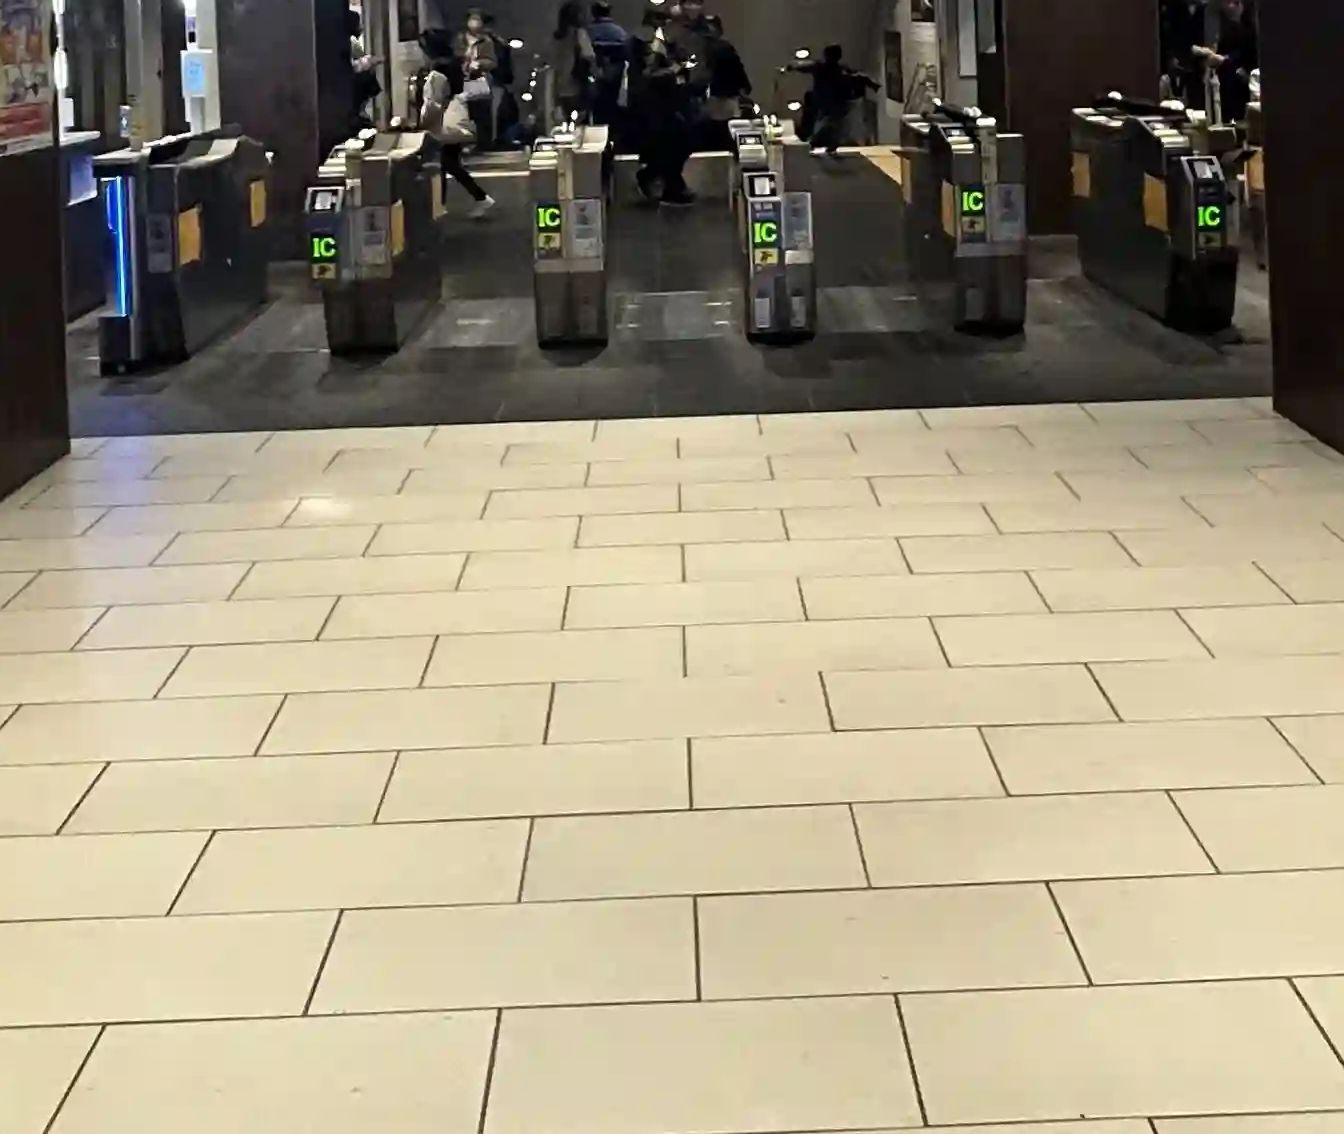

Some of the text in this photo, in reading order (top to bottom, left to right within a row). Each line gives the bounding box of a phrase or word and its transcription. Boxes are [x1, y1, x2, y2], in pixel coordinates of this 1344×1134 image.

[962, 192, 984, 211] IC
[538, 207, 561, 227] IC
[1197, 205, 1220, 226] IC
[753, 223, 777, 243] IC
[313, 237, 336, 258] IC
